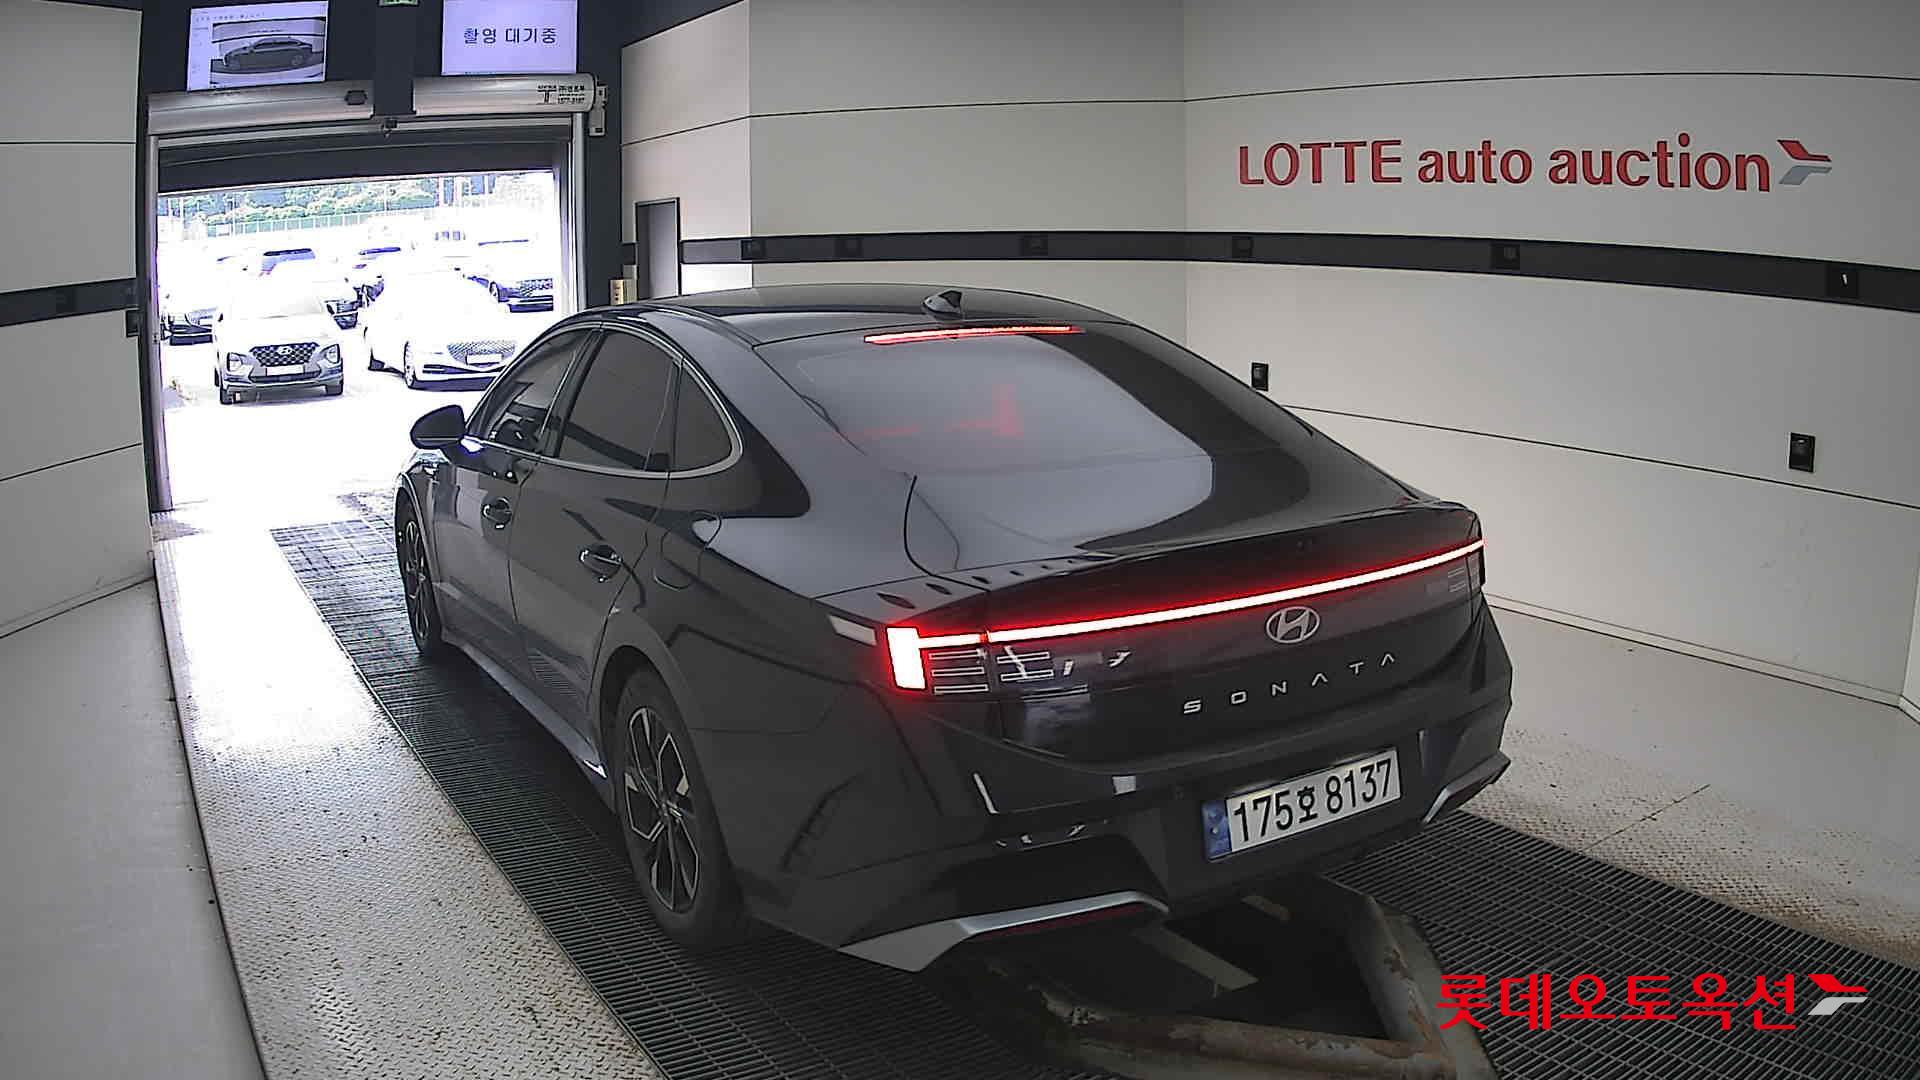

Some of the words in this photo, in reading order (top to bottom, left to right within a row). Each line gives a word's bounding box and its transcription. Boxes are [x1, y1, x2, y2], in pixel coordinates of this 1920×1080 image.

[463, 27, 497, 44] 촬영
[505, 27, 557, 44] 대기중
[1239, 139, 1402, 185] LOTTE
[1417, 140, 1533, 185] auto
[1548, 132, 1770, 192] auction
[1183, 653, 1396, 714] SONATA
[1234, 785, 1318, 842] 175호
[1325, 758, 1392, 814] 8137
